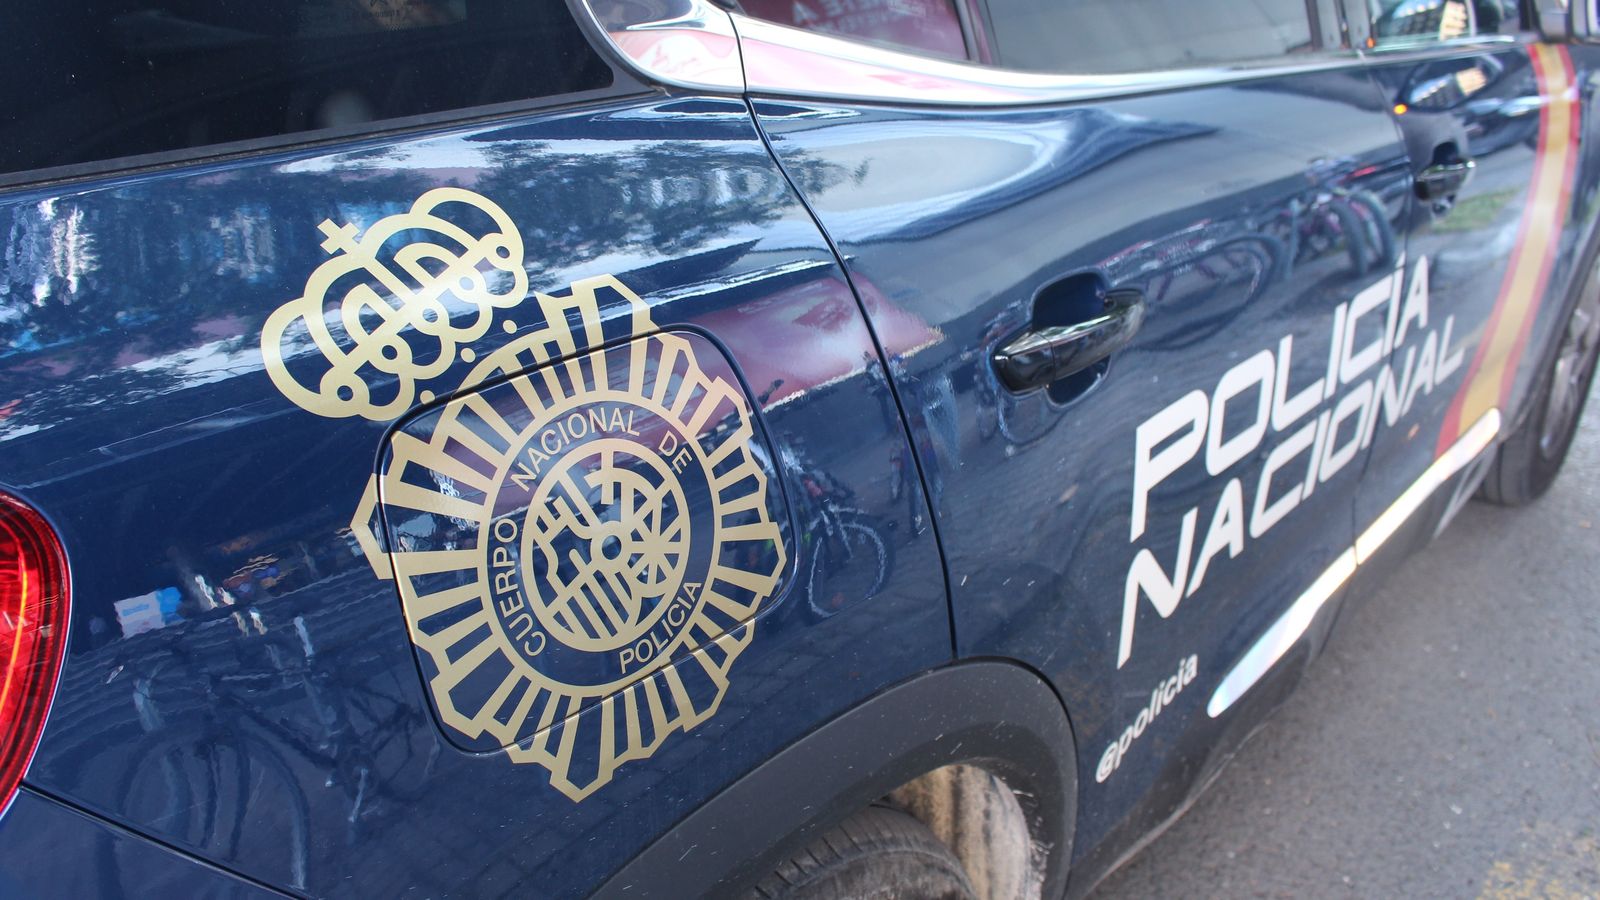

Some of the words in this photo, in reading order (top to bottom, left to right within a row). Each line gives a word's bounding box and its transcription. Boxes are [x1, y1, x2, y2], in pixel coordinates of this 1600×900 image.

[510, 407, 641, 492] NACIONAL
[658, 430, 693, 475] DE
[1130, 251, 1429, 543] POLICÍA
[1117, 315, 1465, 670] NACIONAL
[492, 518, 547, 657] CUERPO
[619, 582, 702, 674] POLICIA
[1095, 653, 1199, 784] @policia
